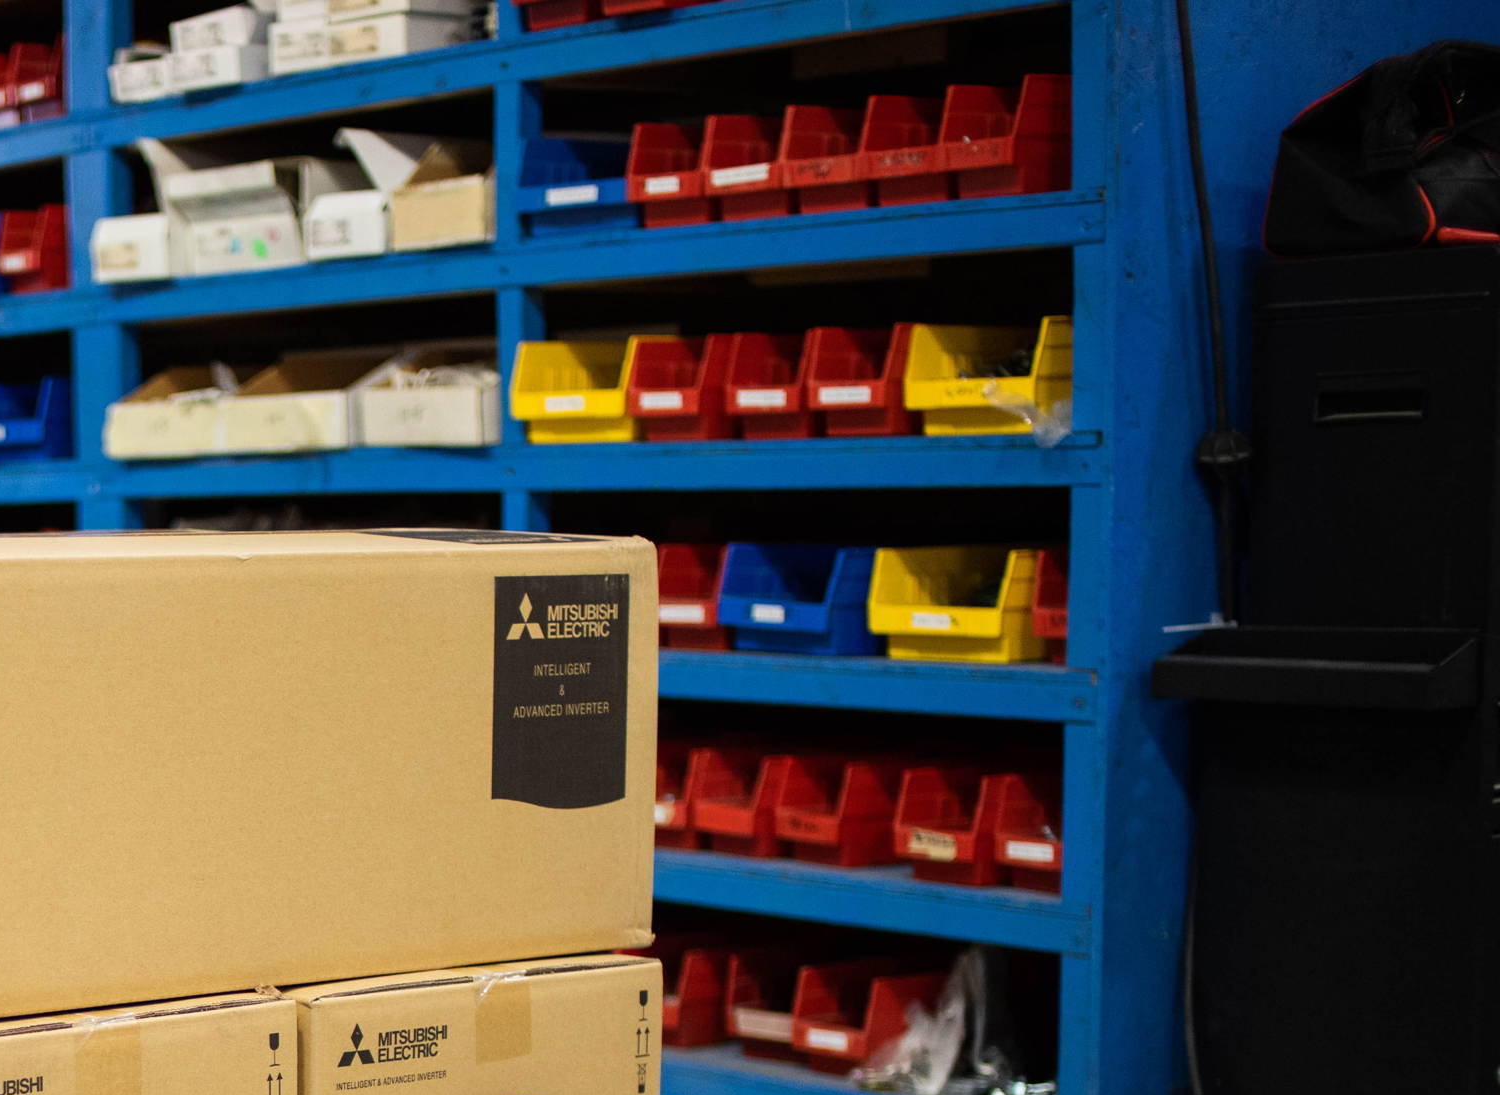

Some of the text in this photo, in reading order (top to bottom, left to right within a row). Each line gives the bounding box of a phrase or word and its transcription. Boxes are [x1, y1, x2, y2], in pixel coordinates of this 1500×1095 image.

[547, 603, 618, 622] MITSUBISHI
[547, 621, 610, 639] ELECTRIC
[533, 663, 591, 677] INTELLIGENT
[559, 684, 565, 696] &
[513, 701, 610, 718] ADVANCED INVERTER
[378, 1024, 447, 1047] MITSUBISHI
[378, 1042, 438, 1063] ELECTRIC
[336, 1079, 376, 1091] INTELLIGENT
[383, 1073, 415, 1086] ADVANCED
[417, 1070, 447, 1081] INVERTER
